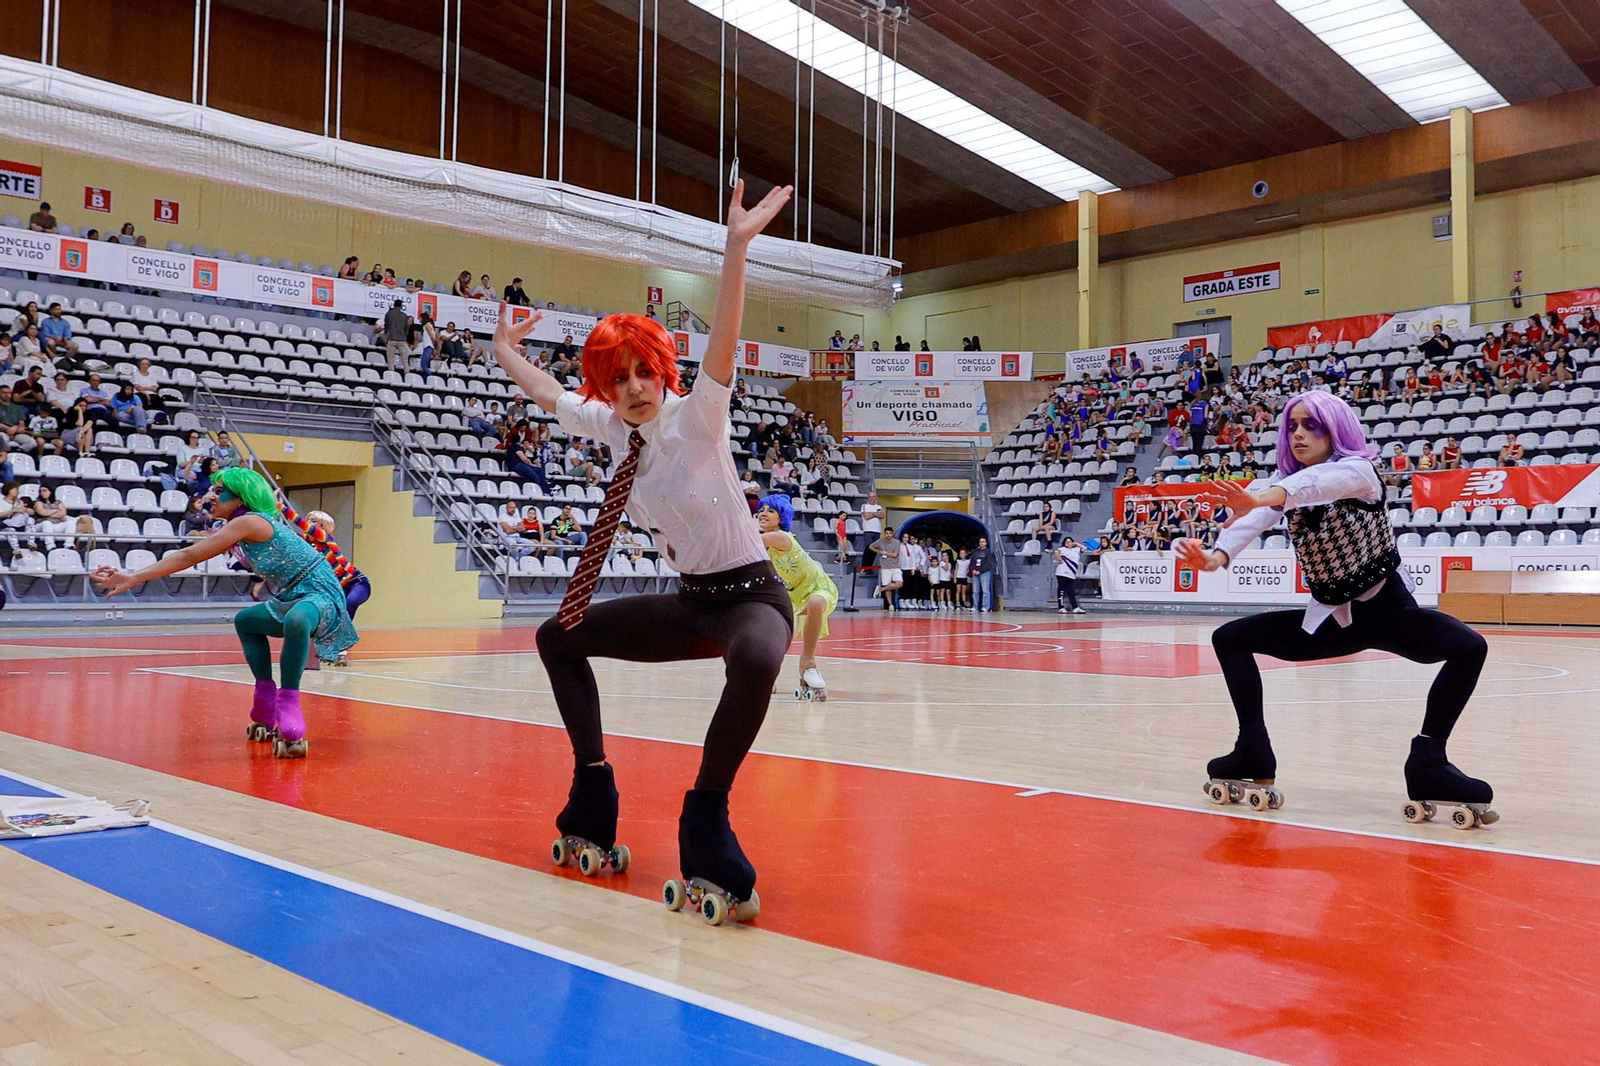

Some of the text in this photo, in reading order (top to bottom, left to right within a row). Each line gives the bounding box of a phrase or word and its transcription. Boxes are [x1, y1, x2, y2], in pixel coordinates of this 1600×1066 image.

[91, 193, 104, 208] B
[160, 206, 173, 219] D
[17, 249, 44, 260] VIGO
[132, 256, 186, 271] CONCELLO
[138, 266, 179, 279] DE VIGO
[257, 274, 305, 288] CONCELLO
[1193, 274, 1271, 297] GRADA ESTE
[262, 285, 300, 297] DE VIGO
[373, 300, 407, 311] DE VO
[468, 306, 500, 317] CONCEL
[472, 315, 500, 325] DE VIG
[558, 319, 593, 330] CONCELLO
[573, 329, 589, 338] VIGO
[1148, 346, 1183, 355] CONCELLO
[779, 352, 807, 362] CONCELLO
[1073, 354, 1106, 364] CONCELLO
[791, 361, 804, 369] VIGO
[1076, 362, 1102, 371] DE VIGO
[875, 401, 917, 410] deporte
[892, 410, 938, 422] VIGO
[1451, 500, 1472, 508] new
[1119, 565, 1167, 574] CONCELLO
[1232, 565, 1287, 574] CONCELLO
[1125, 576, 1161, 584] DE VIGO
[1239, 576, 1281, 585] DE VIGO
